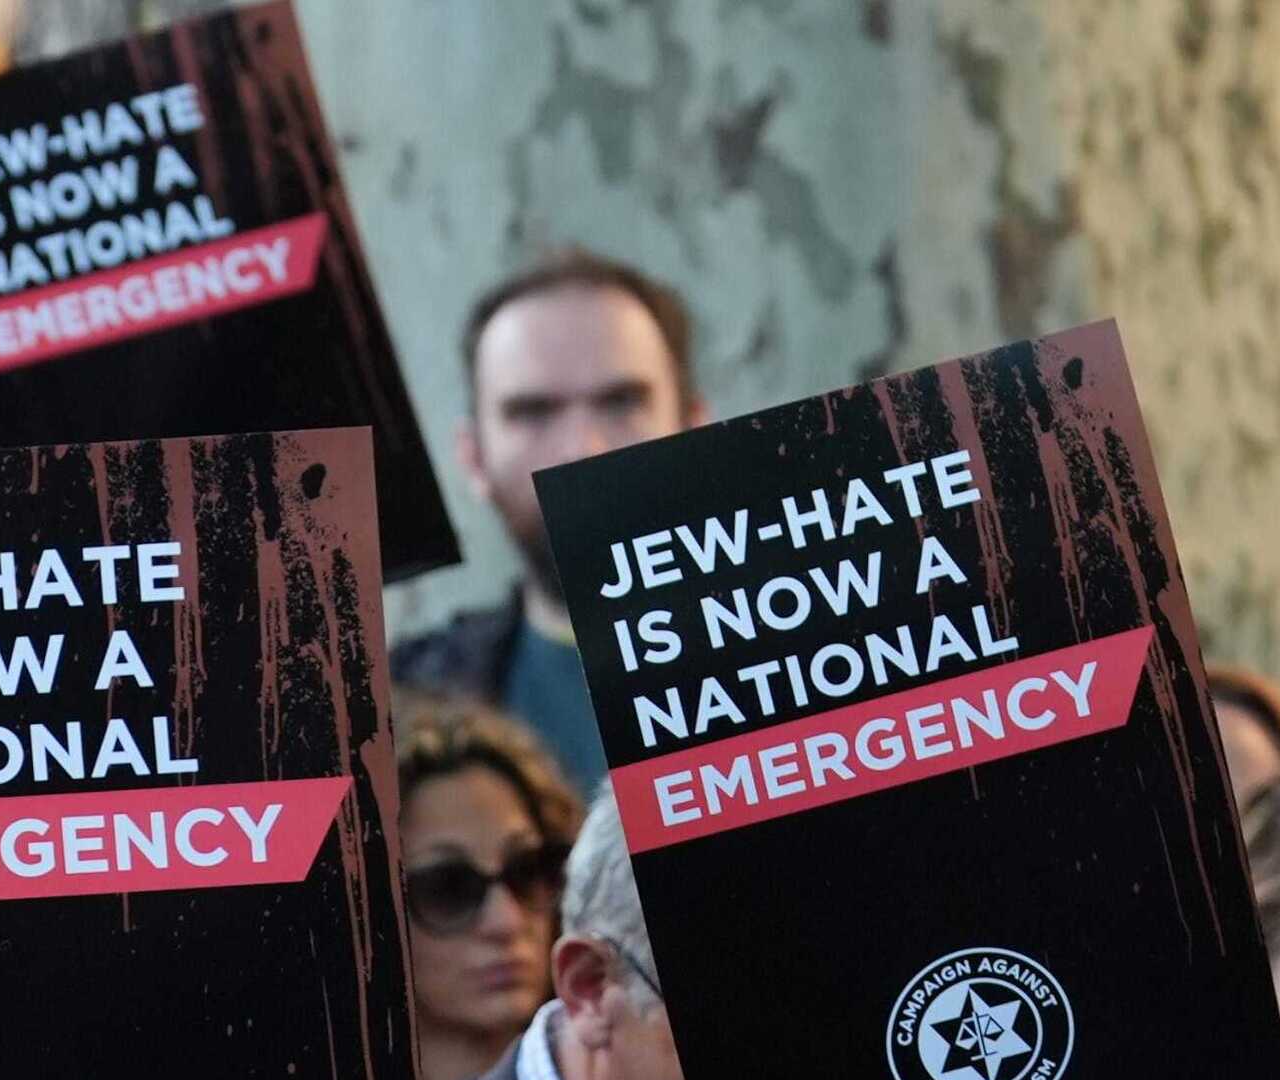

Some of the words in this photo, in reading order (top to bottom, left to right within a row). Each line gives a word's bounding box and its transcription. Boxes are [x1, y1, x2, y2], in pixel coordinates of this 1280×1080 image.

[9, 159, 141, 228] NOW
[154, 145, 198, 194] A
[600, 449, 981, 599] JEW-HATE
[94, 630, 154, 691] A
[613, 610, 683, 672] IS
[701, 551, 883, 650] NOW
[915, 536, 967, 594] A
[633, 604, 1019, 749] NATIONAL
[653, 660, 1098, 828] EMERGENCY
[896, 959, 971, 1046] CAMPAIGN
[977, 957, 1058, 1008] AGAINST
